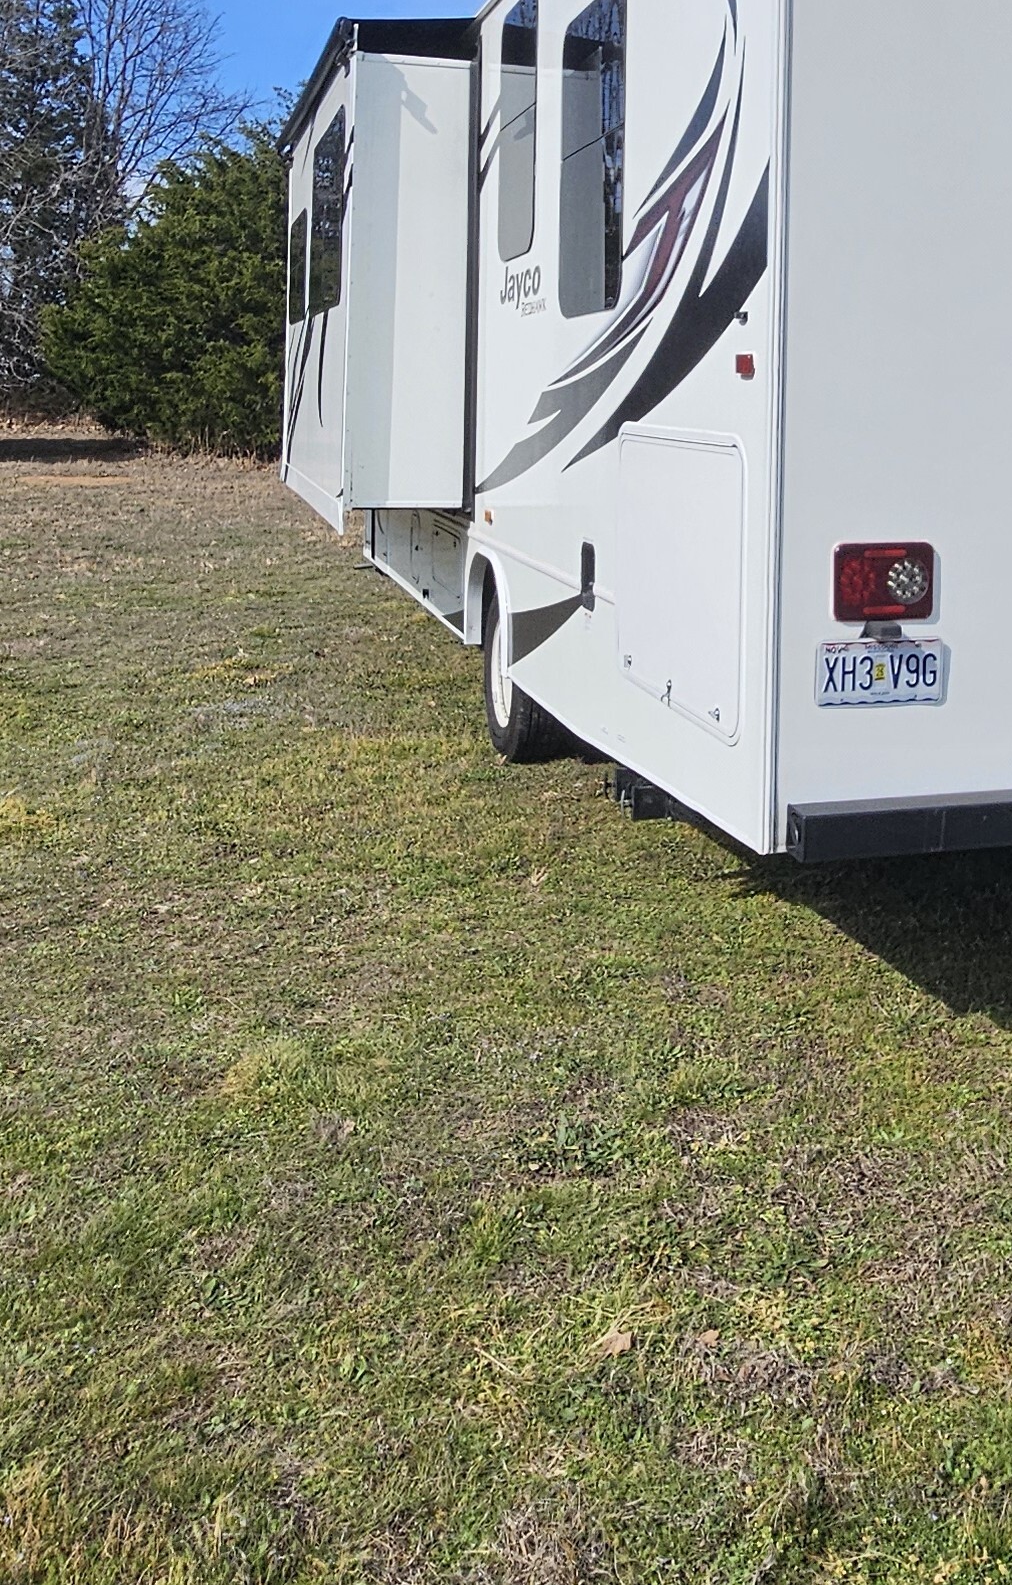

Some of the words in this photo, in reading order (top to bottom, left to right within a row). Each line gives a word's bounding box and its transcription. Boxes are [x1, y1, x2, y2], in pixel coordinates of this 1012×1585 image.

[500, 265, 541, 310] Jayco
[823, 656, 873, 693] XH3
[890, 653, 937, 689] V9G
